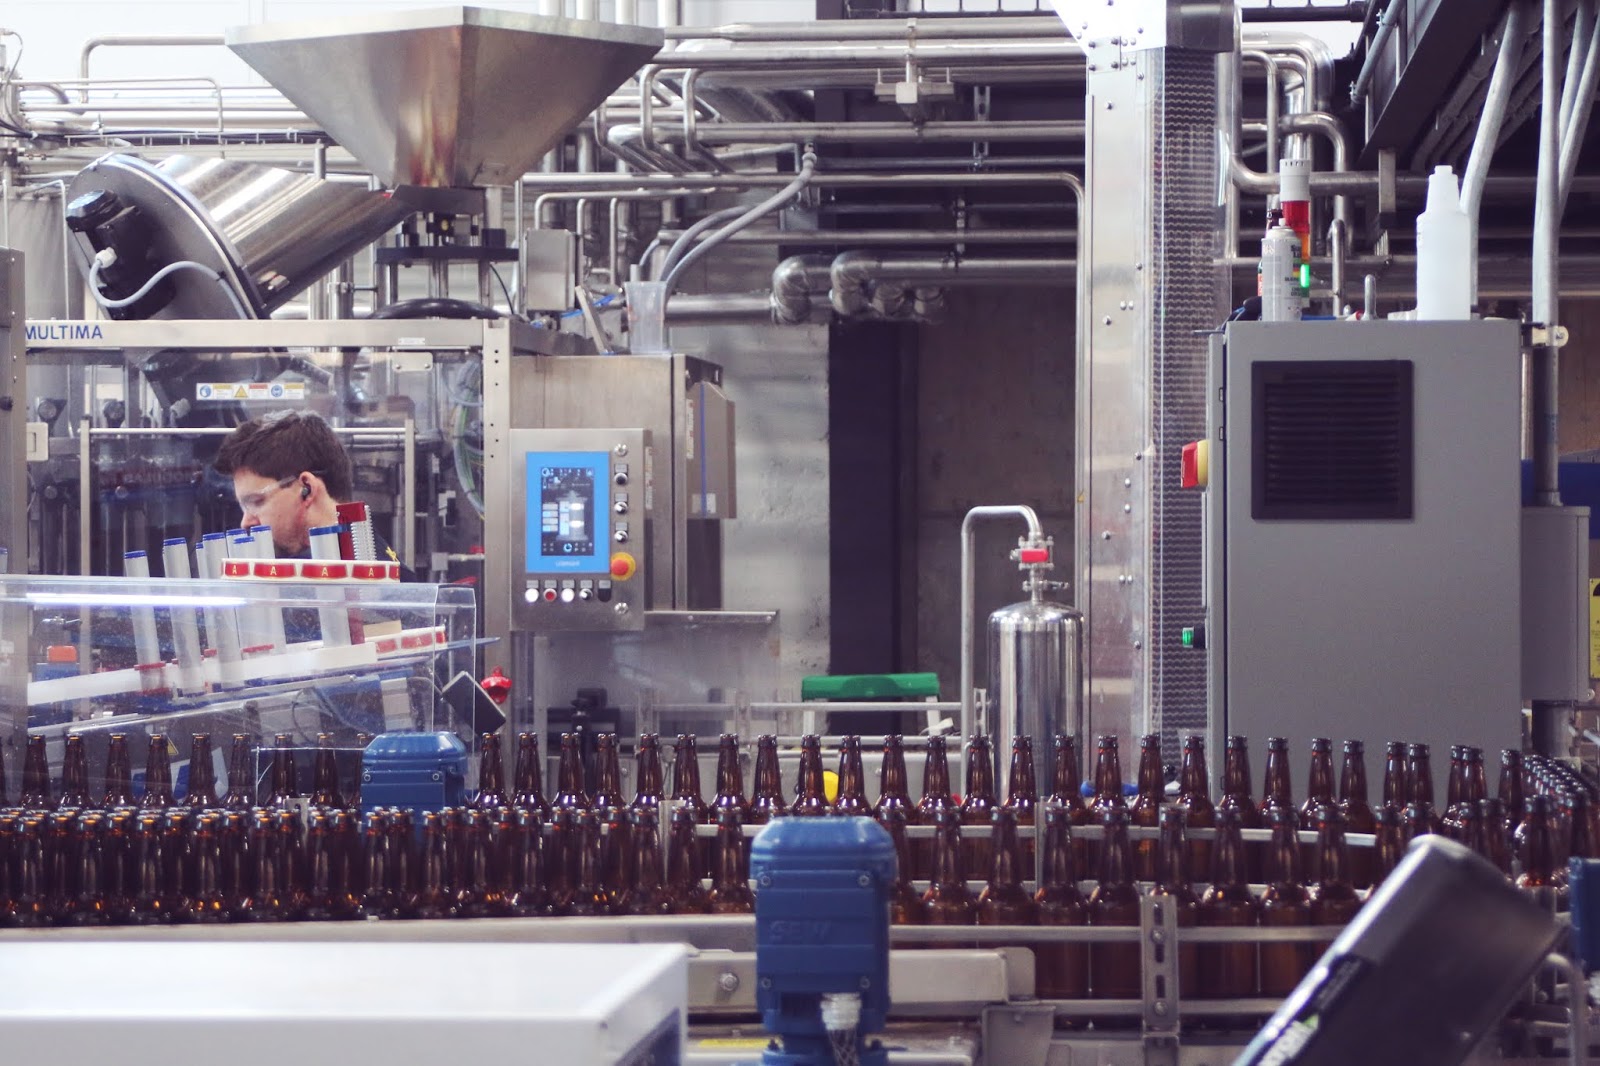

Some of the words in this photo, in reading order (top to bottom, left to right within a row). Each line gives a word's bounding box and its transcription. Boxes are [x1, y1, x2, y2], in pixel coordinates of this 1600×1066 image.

[25, 325, 103, 339] MULTIMA
[270, 565, 277, 576] A
[321, 566, 329, 577] A
[368, 567, 375, 577] A
